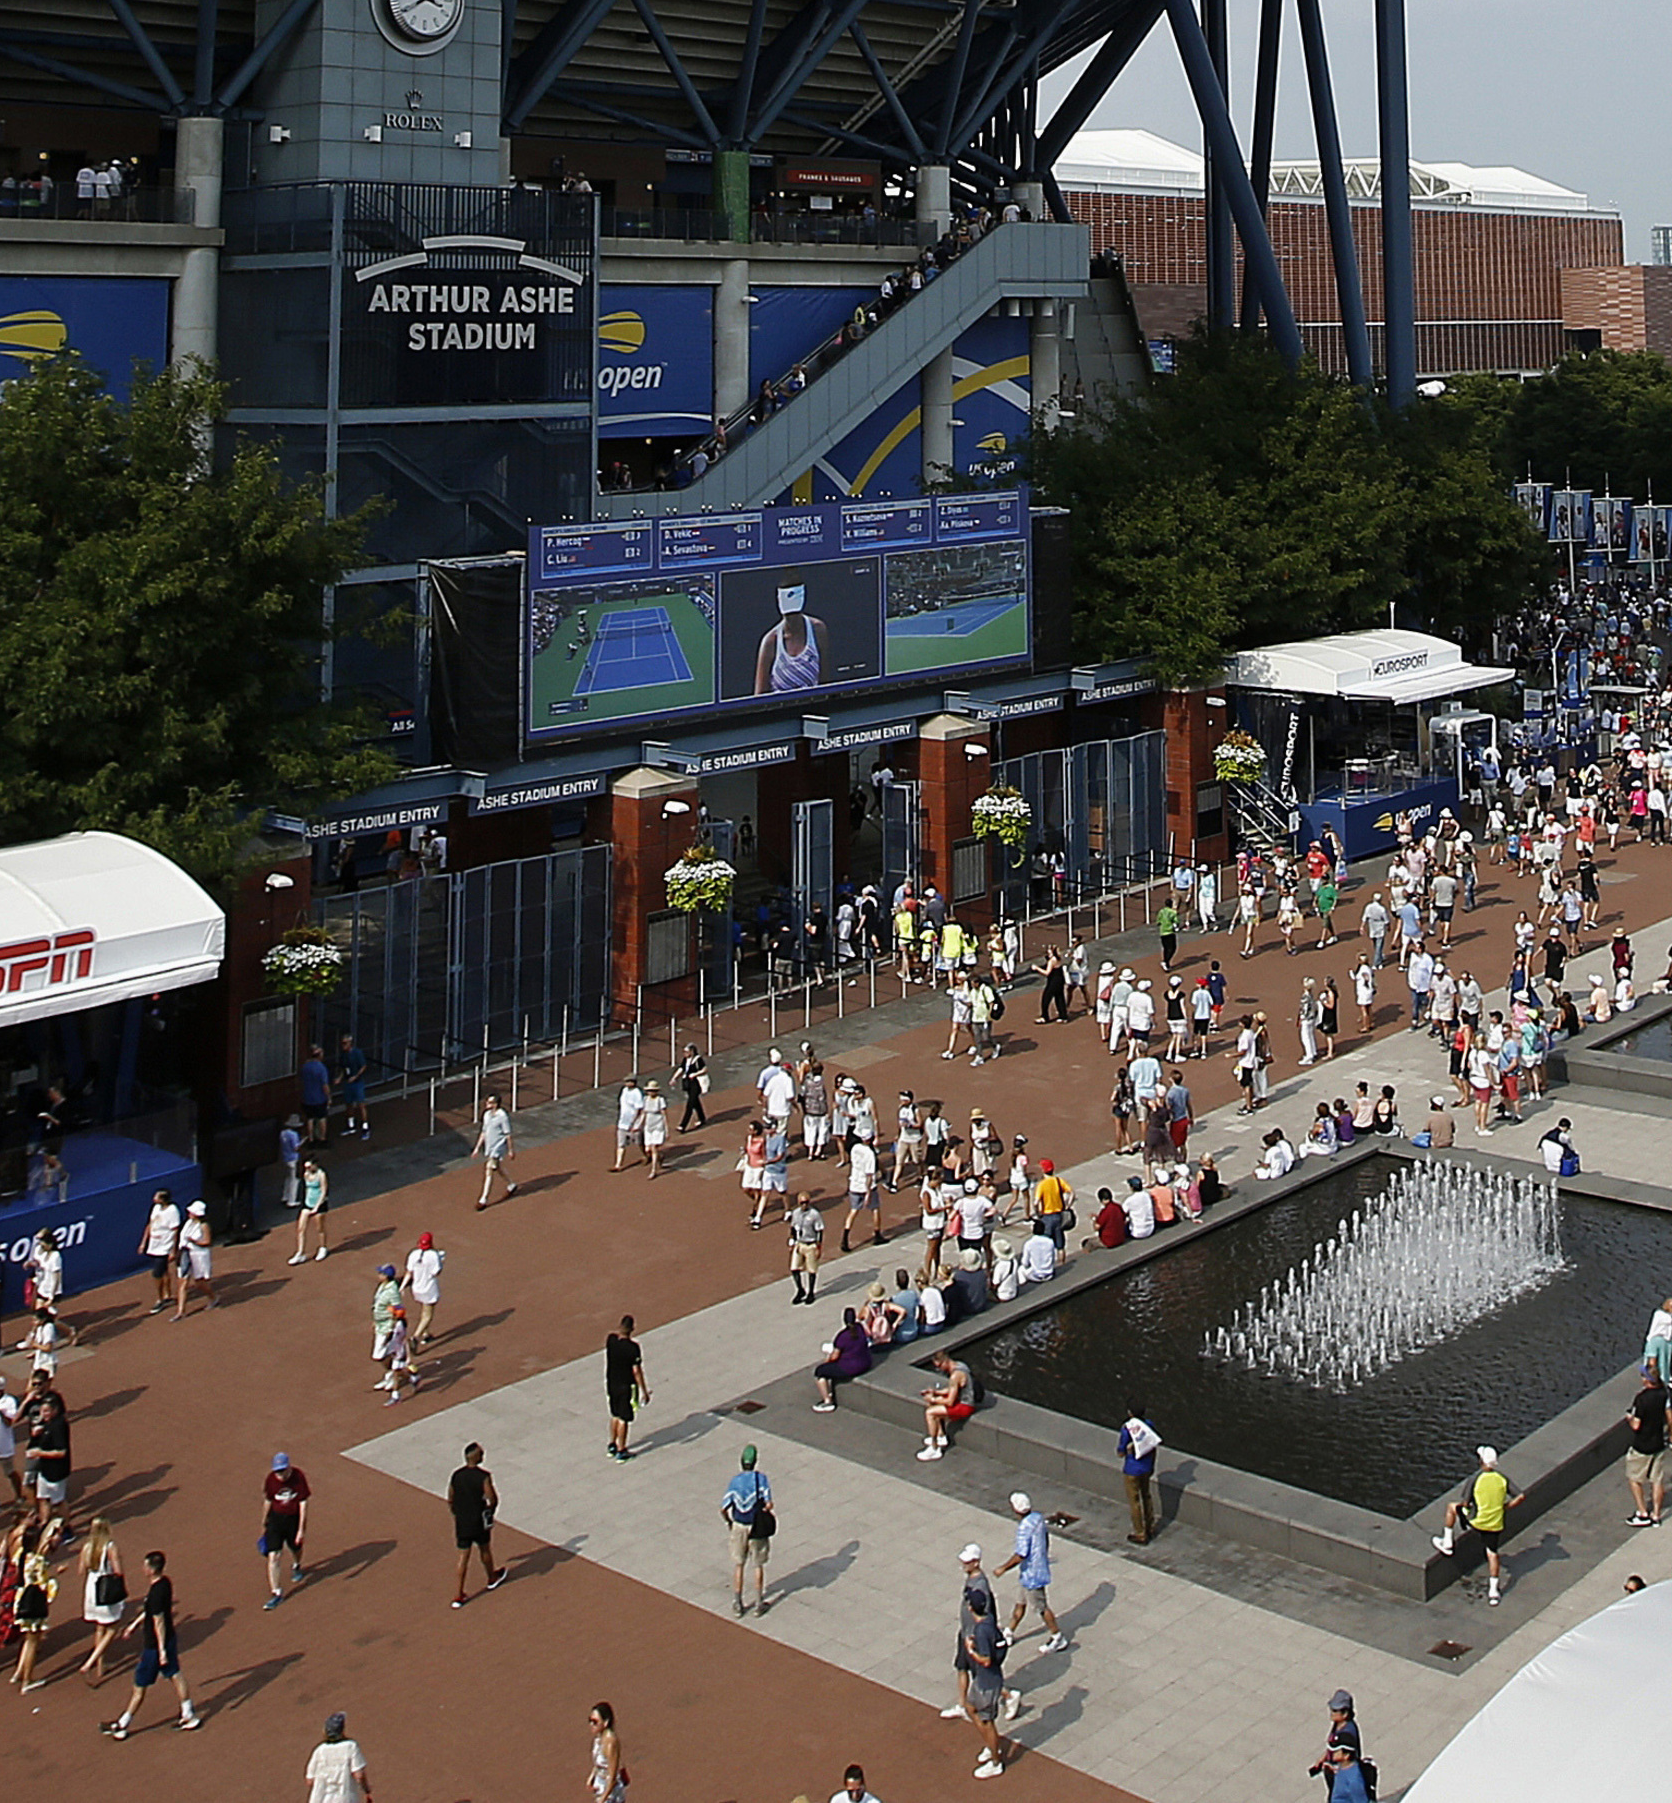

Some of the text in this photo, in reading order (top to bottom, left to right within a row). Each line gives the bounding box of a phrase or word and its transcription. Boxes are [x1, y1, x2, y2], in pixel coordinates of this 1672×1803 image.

[385, 113, 443, 131] ROLEX
[368, 285, 574, 313] ARTHUR ASHE
[408, 323, 535, 350] STADIUM
[778, 516, 812, 528] MATCHES
[781, 524, 820, 537] PROGRESS
[1377, 654, 1428, 675] EUROSPORT
[1081, 679, 1157, 701] ASHE STADIUM ENTRY
[1000, 700, 1033, 716] STADIUM
[1034, 697, 1059, 711] ENTRY
[818, 724, 911, 751] ASHE STADIUM ENTRY
[714, 750, 757, 771] STADIUM
[759, 746, 789, 762] ENTRY
[477, 778, 599, 811] ASHE STADIUM ENTRY
[304, 805, 440, 839] ASHE STADIUM ENTRY
